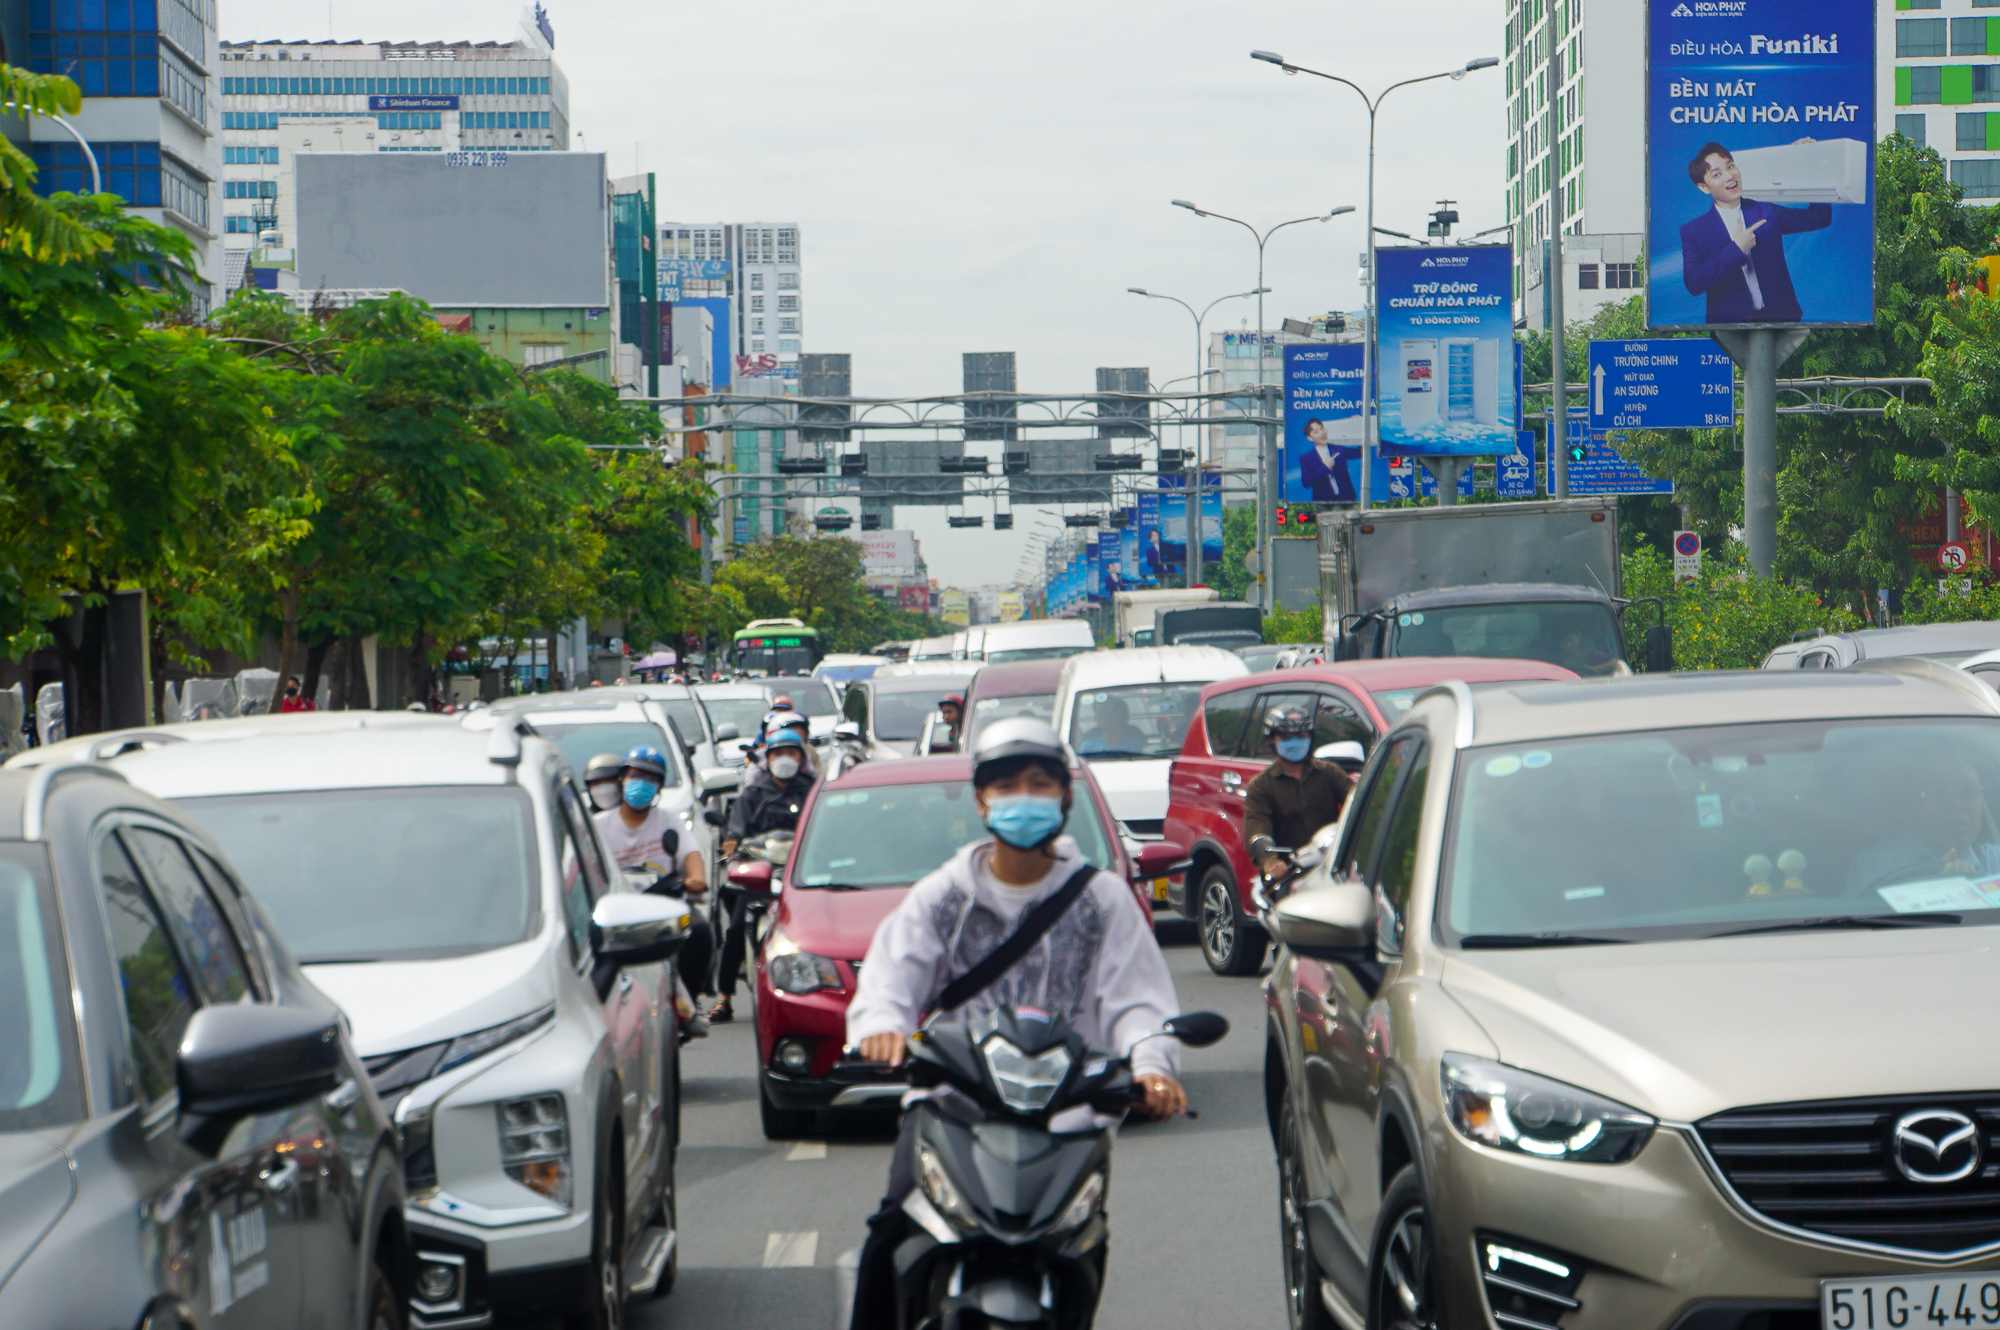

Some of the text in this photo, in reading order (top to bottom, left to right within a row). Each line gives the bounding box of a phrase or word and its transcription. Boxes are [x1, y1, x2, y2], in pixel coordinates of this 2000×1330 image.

[1670, 34, 1838, 55] ĐIỀU HÒA Funiki
[1670, 78, 1757, 97] BỀN MÁT
[389, 99, 451, 107] Shinhan Finance
[1670, 100, 1859, 124] CHUẨN HÒA PHÁT
[447, 153, 508, 166] 0935 220 999
[1413, 282, 1478, 293] TRỮ ĐÔNG
[1390, 294, 1502, 308] CHUẨN HÒA PHÁT
[1624, 343, 1648, 352] ĐƯỜNG
[1614, 353, 1730, 367] TRƯỜNG CHINH 2,7 Km
[1330, 368, 1365, 379] Funik
[1624, 372, 1655, 382] NÚT GIAO
[1614, 384, 1730, 397] AN SƯƠNG 7,2 Km
[1624, 402, 1647, 412] HUYỆN
[1614, 412, 1730, 426] CỦ CHI 18 Km
[1508, 481, 1516, 489] XE
[1831, 1282, 2000, 1330] 51G-449
